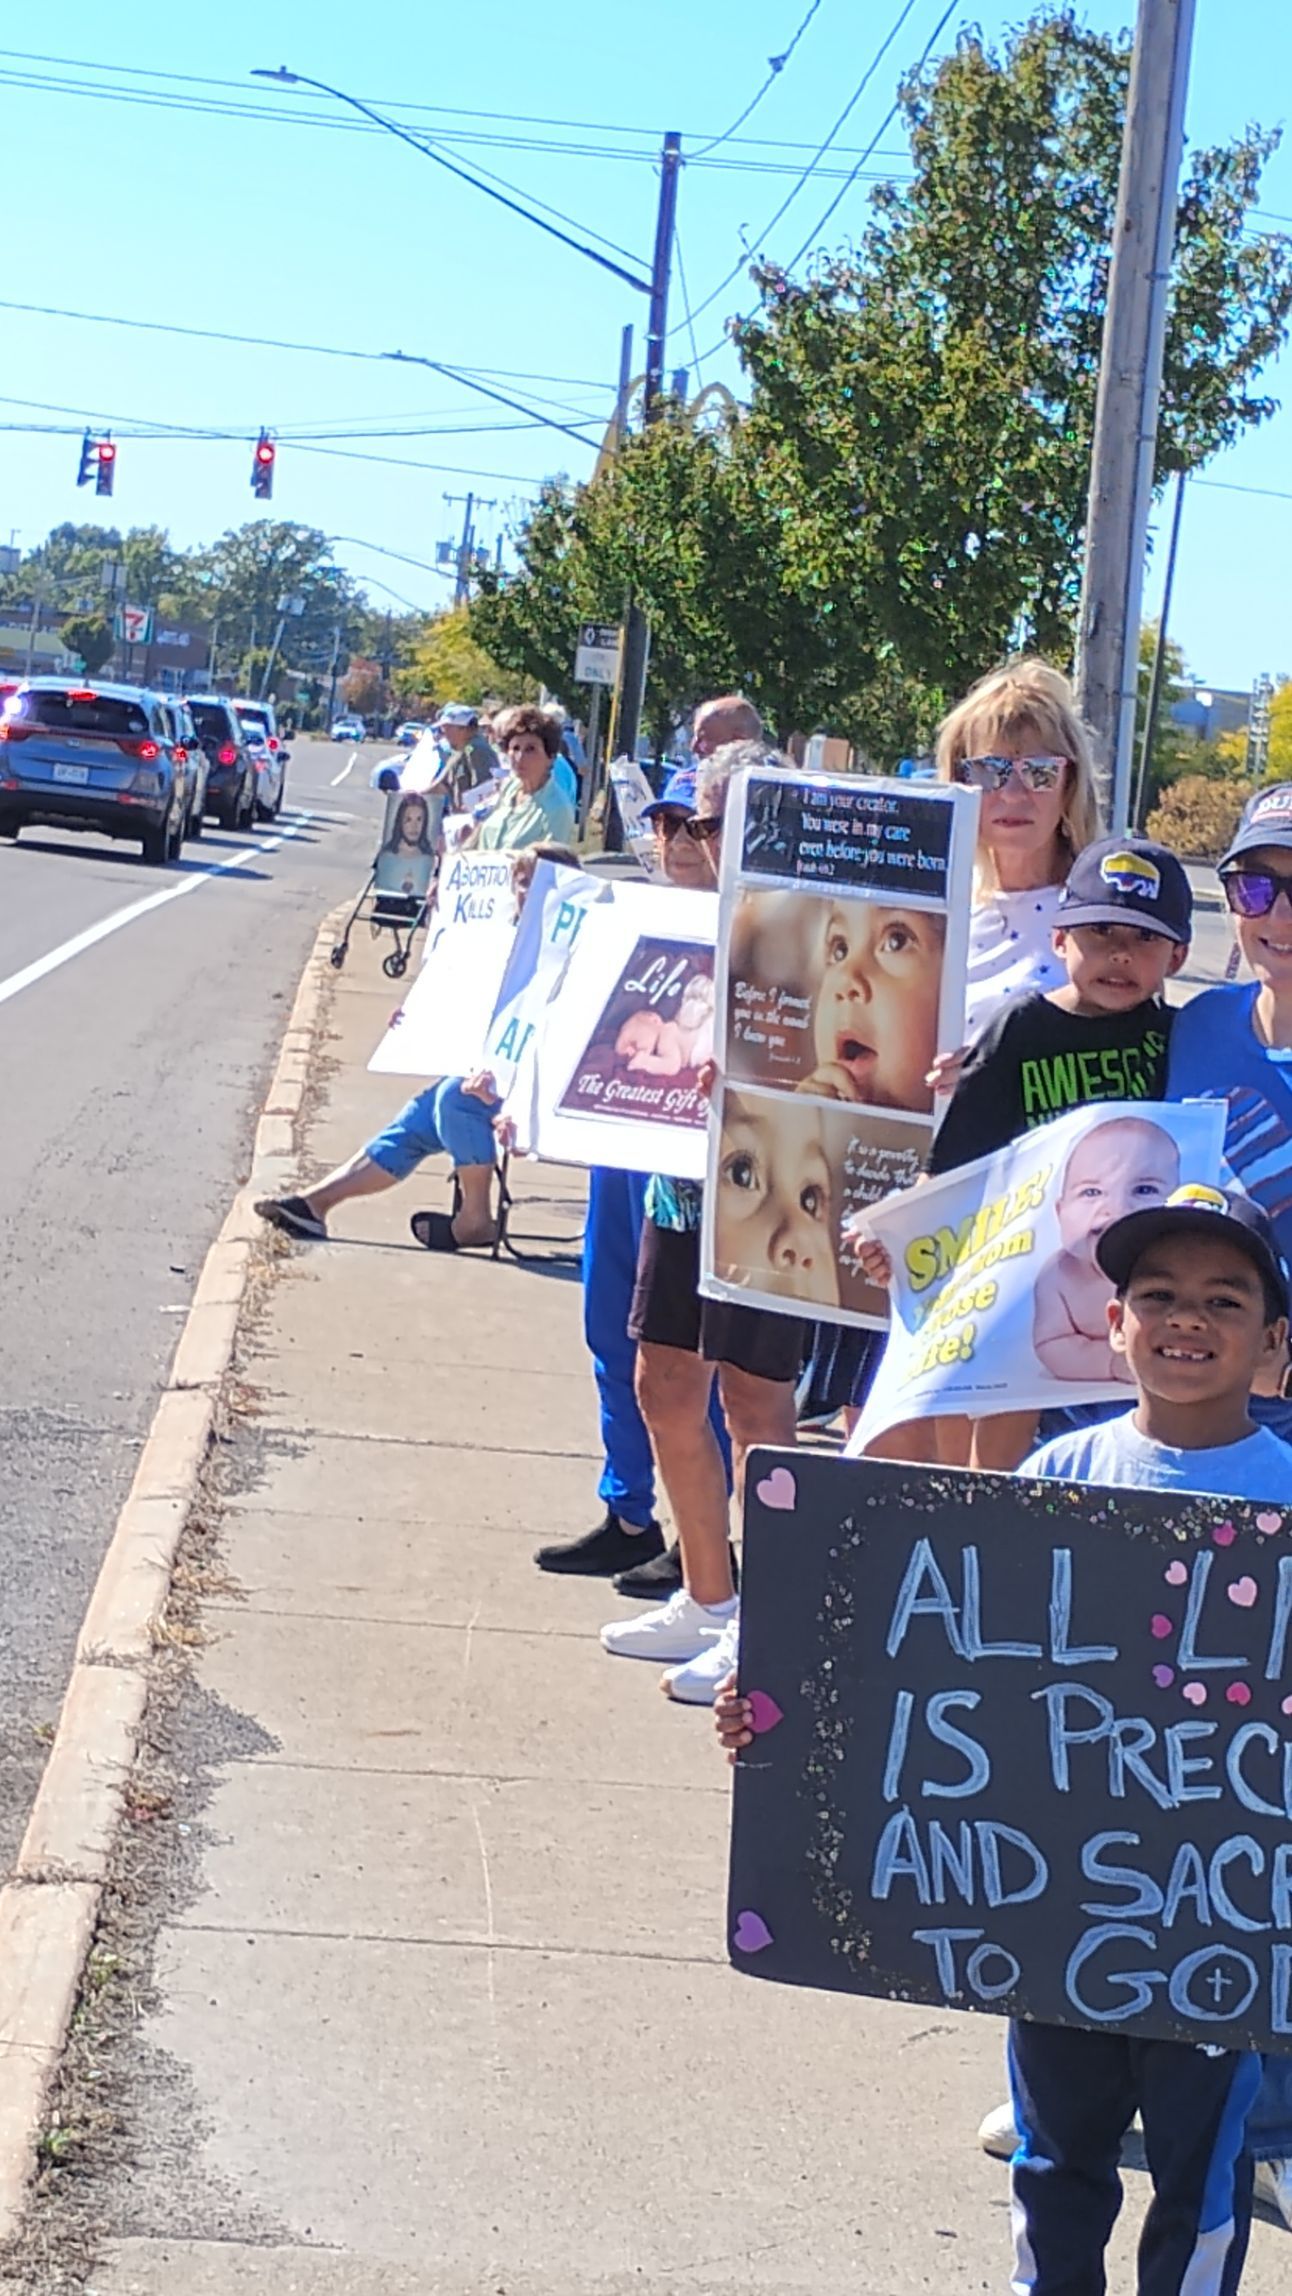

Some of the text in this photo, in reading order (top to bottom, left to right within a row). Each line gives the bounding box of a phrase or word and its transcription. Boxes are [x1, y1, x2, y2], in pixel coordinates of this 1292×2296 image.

[802, 788, 809, 804] I
[811, 792, 828, 806] am
[829, 794, 853, 815] your
[802, 812, 911, 841] You were in my care
[799, 841, 824, 858] even
[825, 838, 860, 861] before
[860, 847, 885, 869] you
[886, 852, 916, 868] were
[453, 893, 495, 923] KILLS
[624, 955, 689, 1005] Life
[735, 980, 813, 1010] Before I formed
[734, 1007, 751, 1022] you
[753, 1010, 764, 1021] in
[765, 1007, 780, 1025] the
[734, 1021, 786, 1050] I knew you
[578, 1073, 604, 1096] The
[602, 1078, 665, 1103] Greatest
[662, 1087, 698, 1114] Gift
[844, 1157, 856, 1175] to
[856, 1160, 891, 1182] decide
[876, 1147, 919, 1174] poverty
[852, 1180, 884, 1200] child
[904, 1163, 1054, 1293] SMILE!
[922, 1279, 999, 1335] ose
[886, 1537, 1119, 1665] ALL
[883, 1689, 991, 1802] IS
[871, 1803, 1049, 1908] AND
[912, 1927, 1021, 2000] TO
